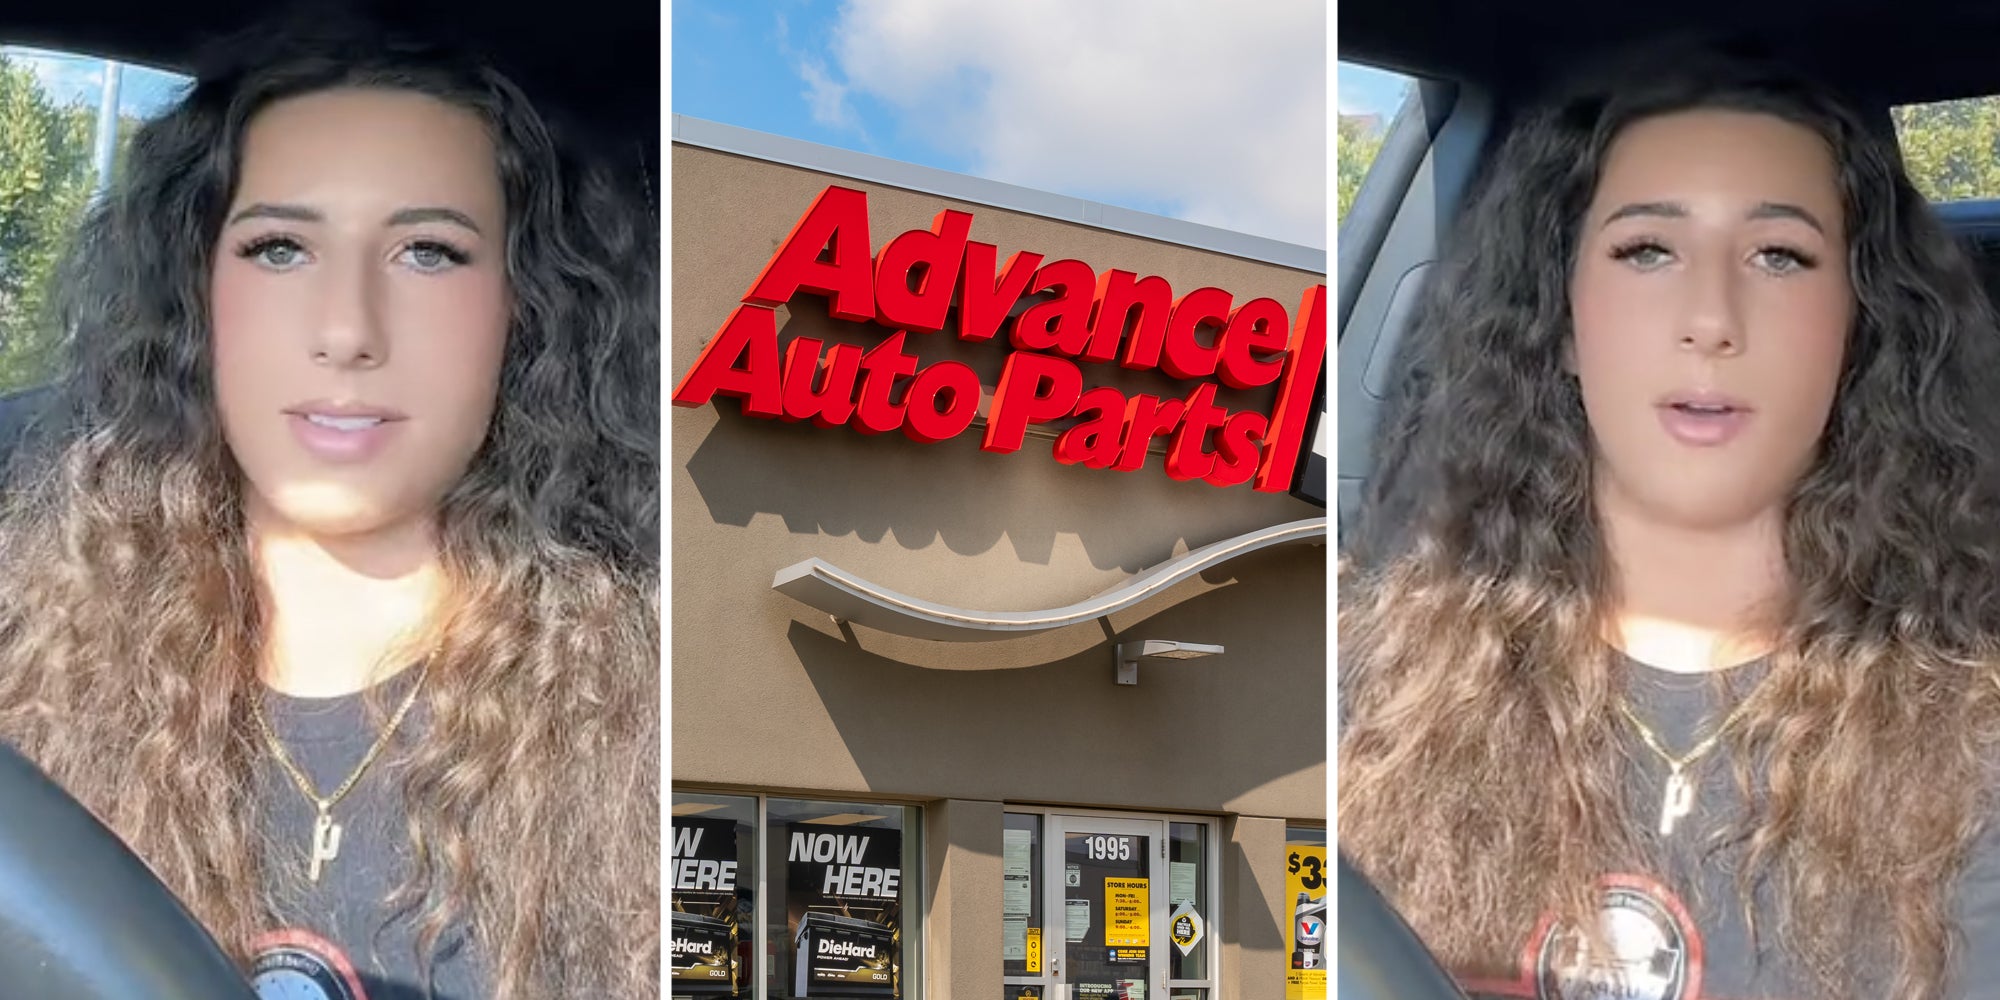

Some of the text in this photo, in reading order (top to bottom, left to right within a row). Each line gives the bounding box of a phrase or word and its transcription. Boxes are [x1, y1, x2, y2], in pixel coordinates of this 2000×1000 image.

[741, 185, 1290, 390] Advance
[672, 304, 1270, 488] Auto Parts
[788, 832, 870, 865] NOW
[1085, 836, 1130, 861] 1995
[822, 865, 901, 898] HERE
[1288, 852, 1327, 890] $3
[818, 939, 876, 959] DieHard
[709, 969, 726, 977] GOLD
[872, 973, 888, 981] GOLD
